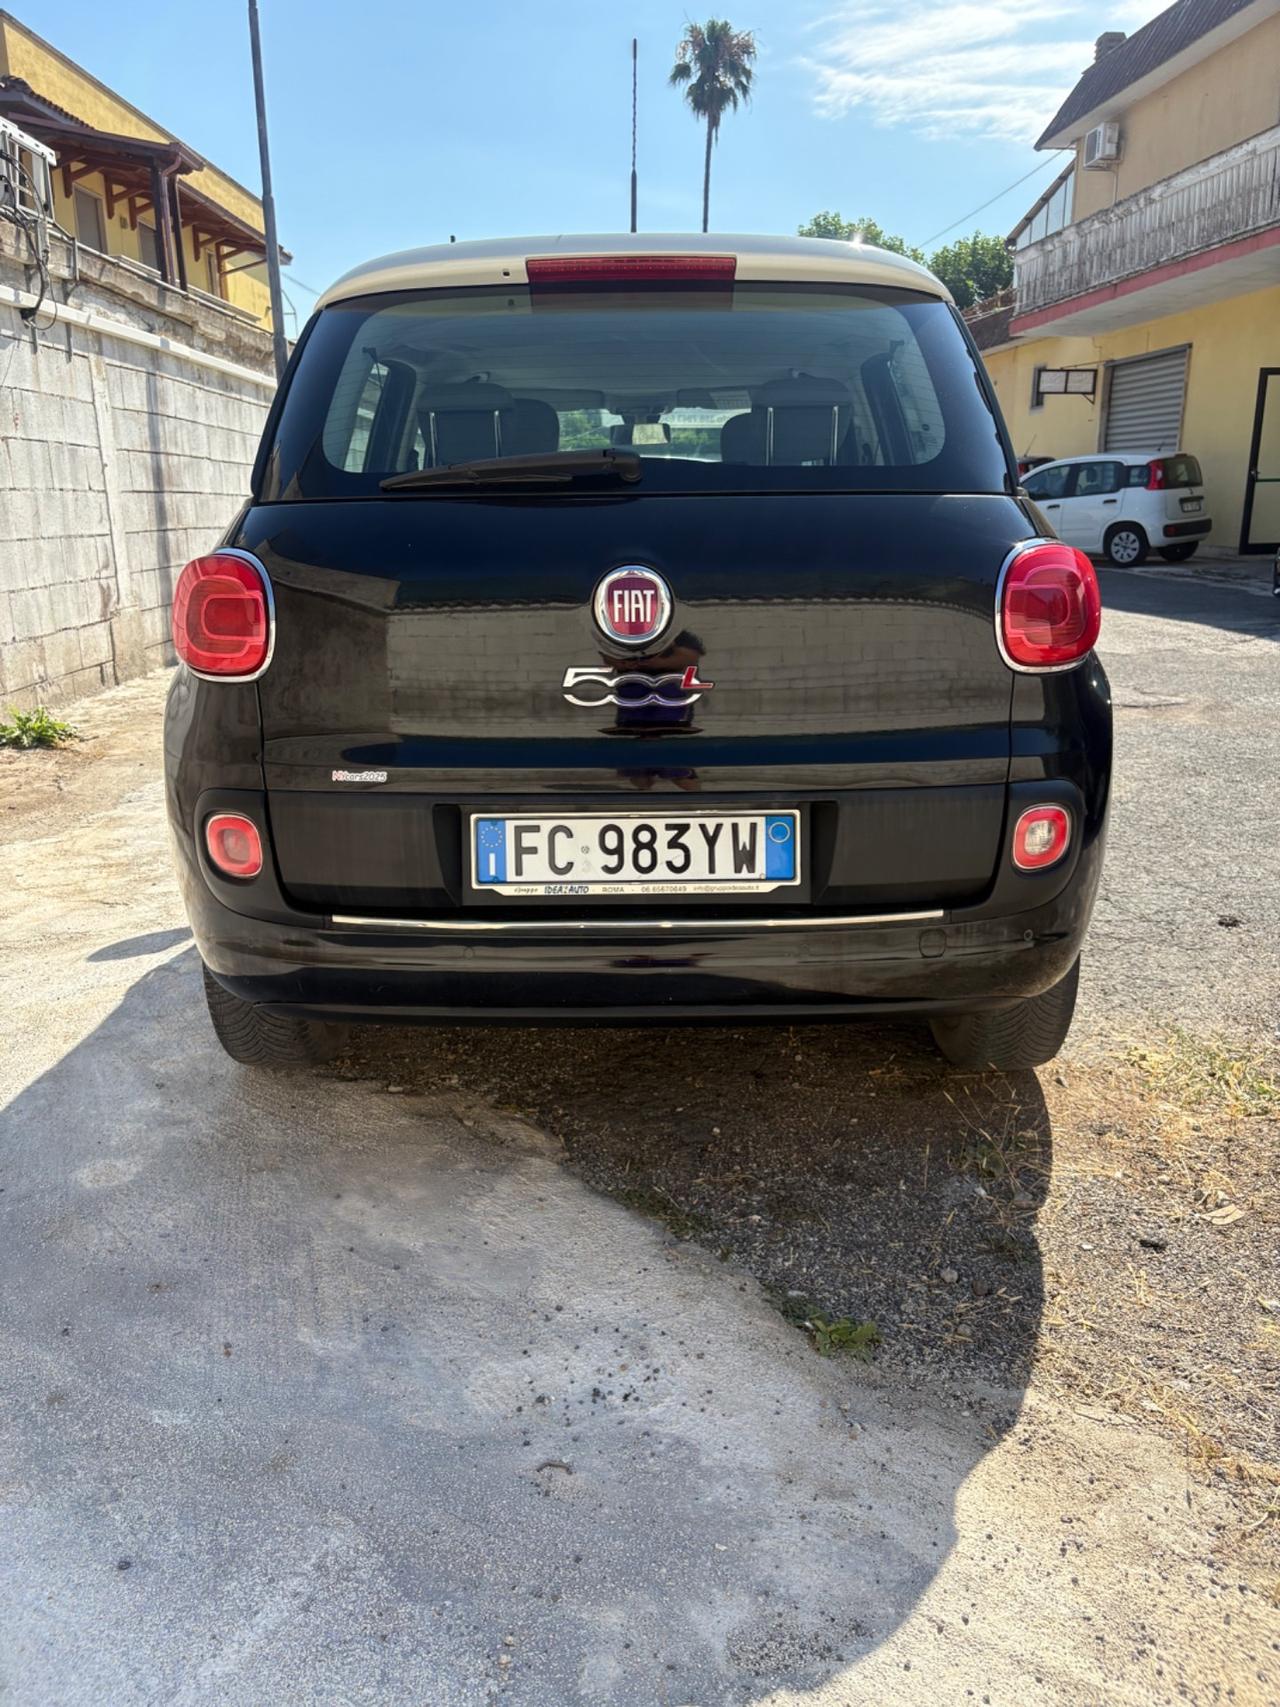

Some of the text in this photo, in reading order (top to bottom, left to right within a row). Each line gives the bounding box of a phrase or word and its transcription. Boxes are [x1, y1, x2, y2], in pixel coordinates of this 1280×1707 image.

[612, 589, 656, 623] FIAT
[562, 665, 714, 707] 500L
[513, 822, 758, 877] FC 983YW
